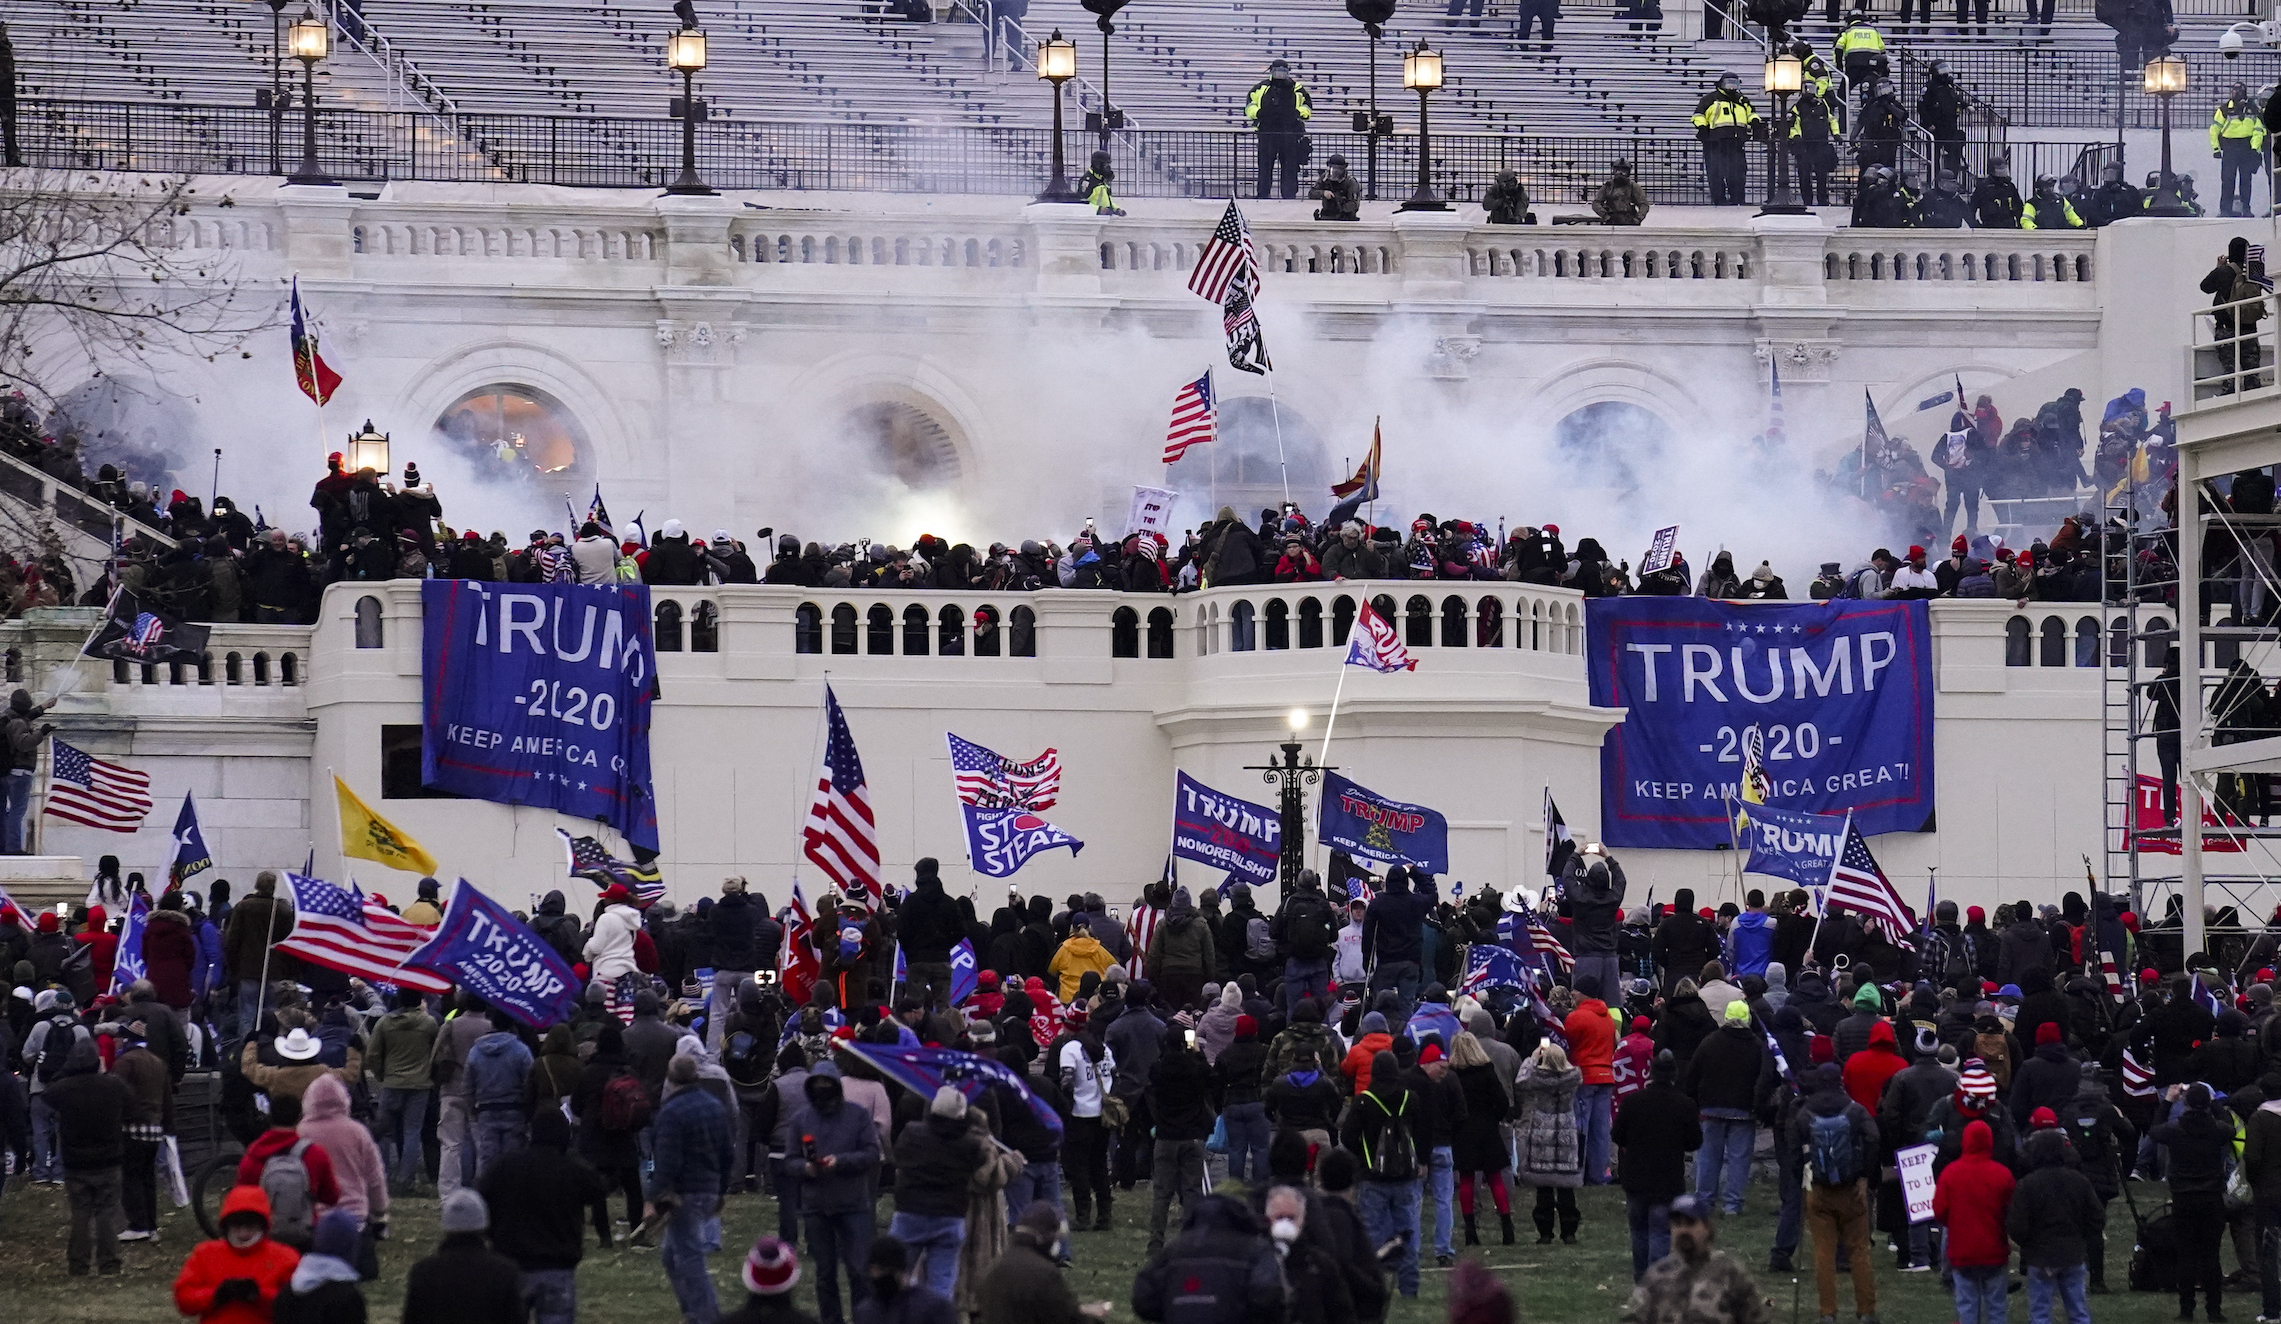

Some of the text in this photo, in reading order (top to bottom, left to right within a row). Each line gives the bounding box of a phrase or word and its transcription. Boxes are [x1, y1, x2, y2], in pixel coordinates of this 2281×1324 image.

[1144, 503, 1161, 512] STOP
[1649, 539, 1661, 563] 2020
[1657, 528, 1675, 568] TRUMP
[467, 581, 646, 688] TRUM
[1626, 631, 1897, 704] TRUMP
[446, 722, 503, 750] KEEP
[510, 734, 599, 769] AMECA
[1634, 762, 1910, 801] KEEP AMICA GREAT!
[976, 810, 1005, 822] FIGHT
[1182, 783, 1281, 843] TRUMP
[1340, 794, 1425, 834] TRUMP
[1333, 835, 1358, 848] KEEP
[1358, 844, 1398, 861] AMERICA
[1801, 859, 1827, 870] GREAT
[467, 909, 565, 999] TRUMP
[456, 960, 504, 999] AMERICA
[1468, 978, 1499, 994] KEEP
[1901, 1153, 1927, 1169] KEEP
[1906, 1179, 1921, 1191] TO
[1909, 1199, 1931, 1214] CON
